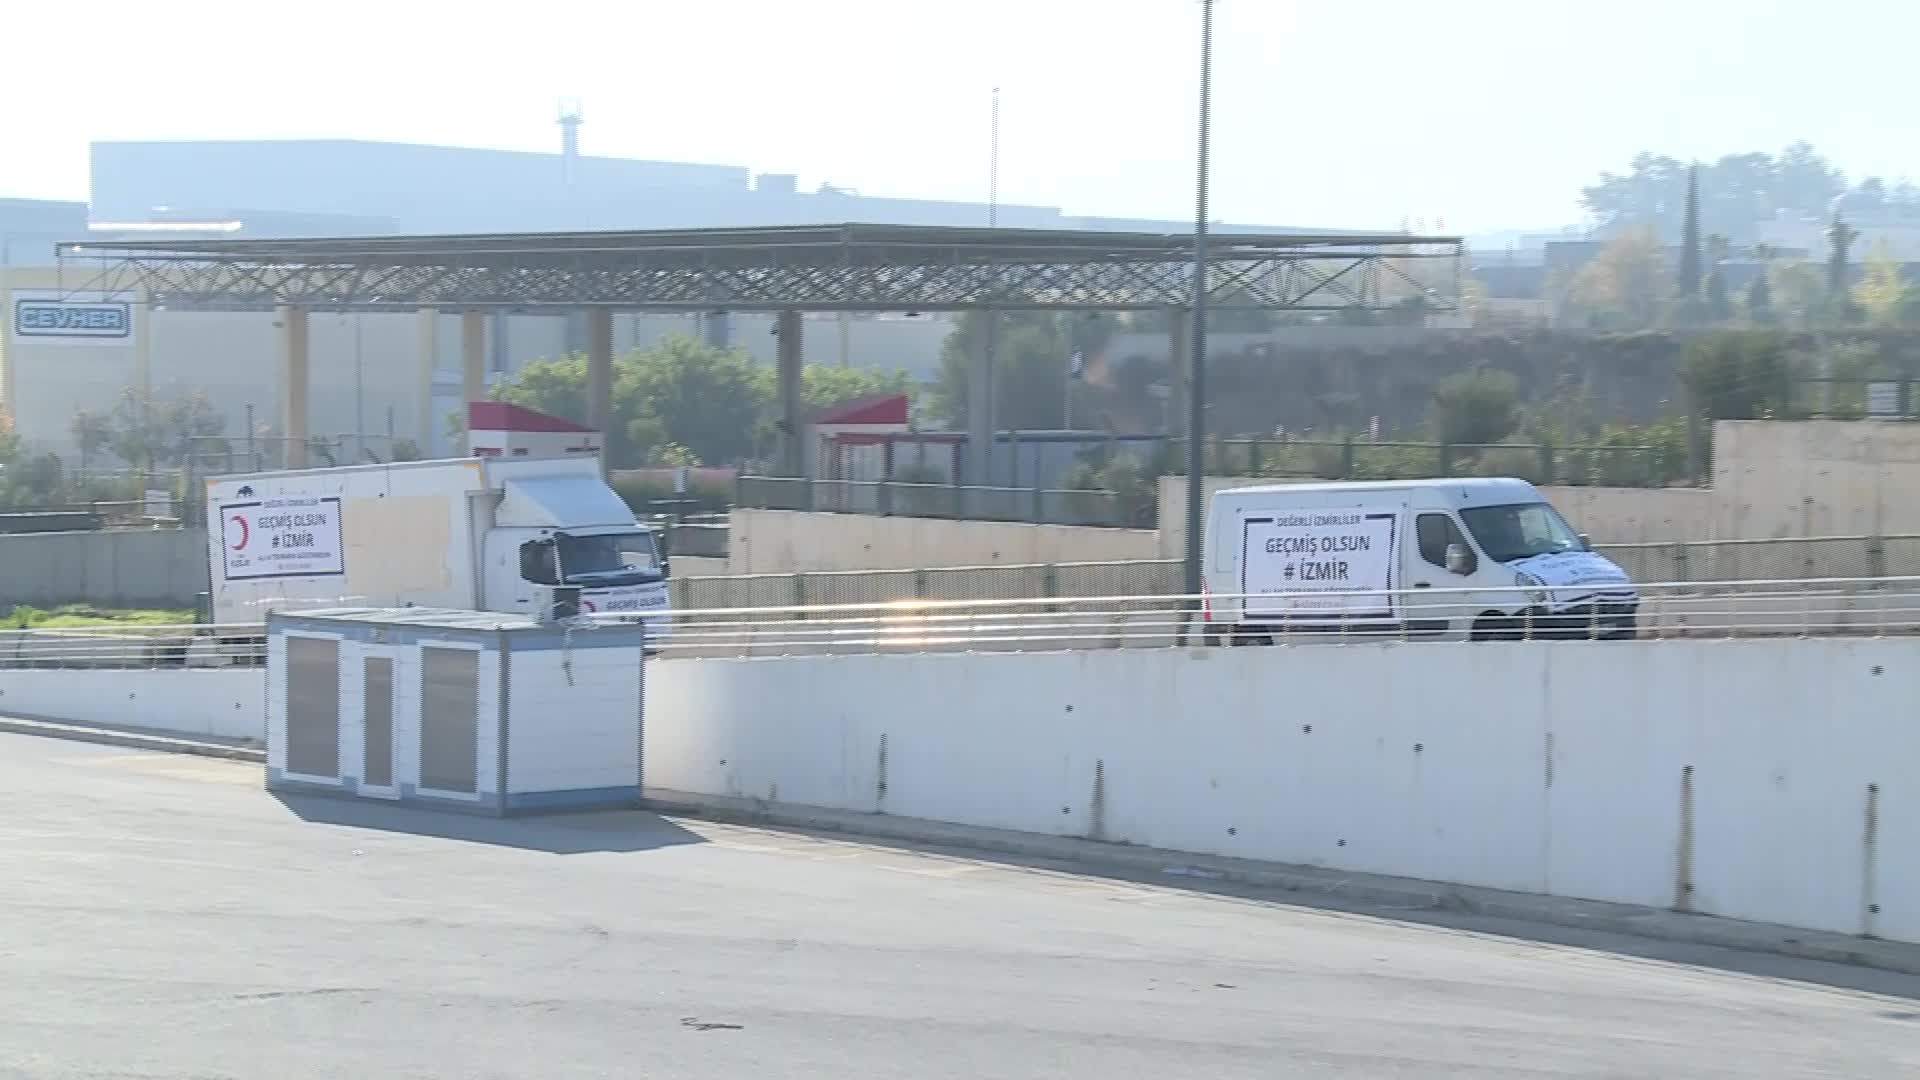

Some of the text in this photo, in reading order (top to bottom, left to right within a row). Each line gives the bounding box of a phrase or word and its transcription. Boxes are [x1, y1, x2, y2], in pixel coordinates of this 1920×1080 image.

[20, 308, 124, 329] CEVHER
[257, 512, 327, 531] GEÇMİŞ OLSUN
[272, 530, 315, 549] # İZMİR
[1265, 533, 1370, 557] GEÇMİŞ OLSUN
[1283, 556, 1349, 581] # İZMİR
